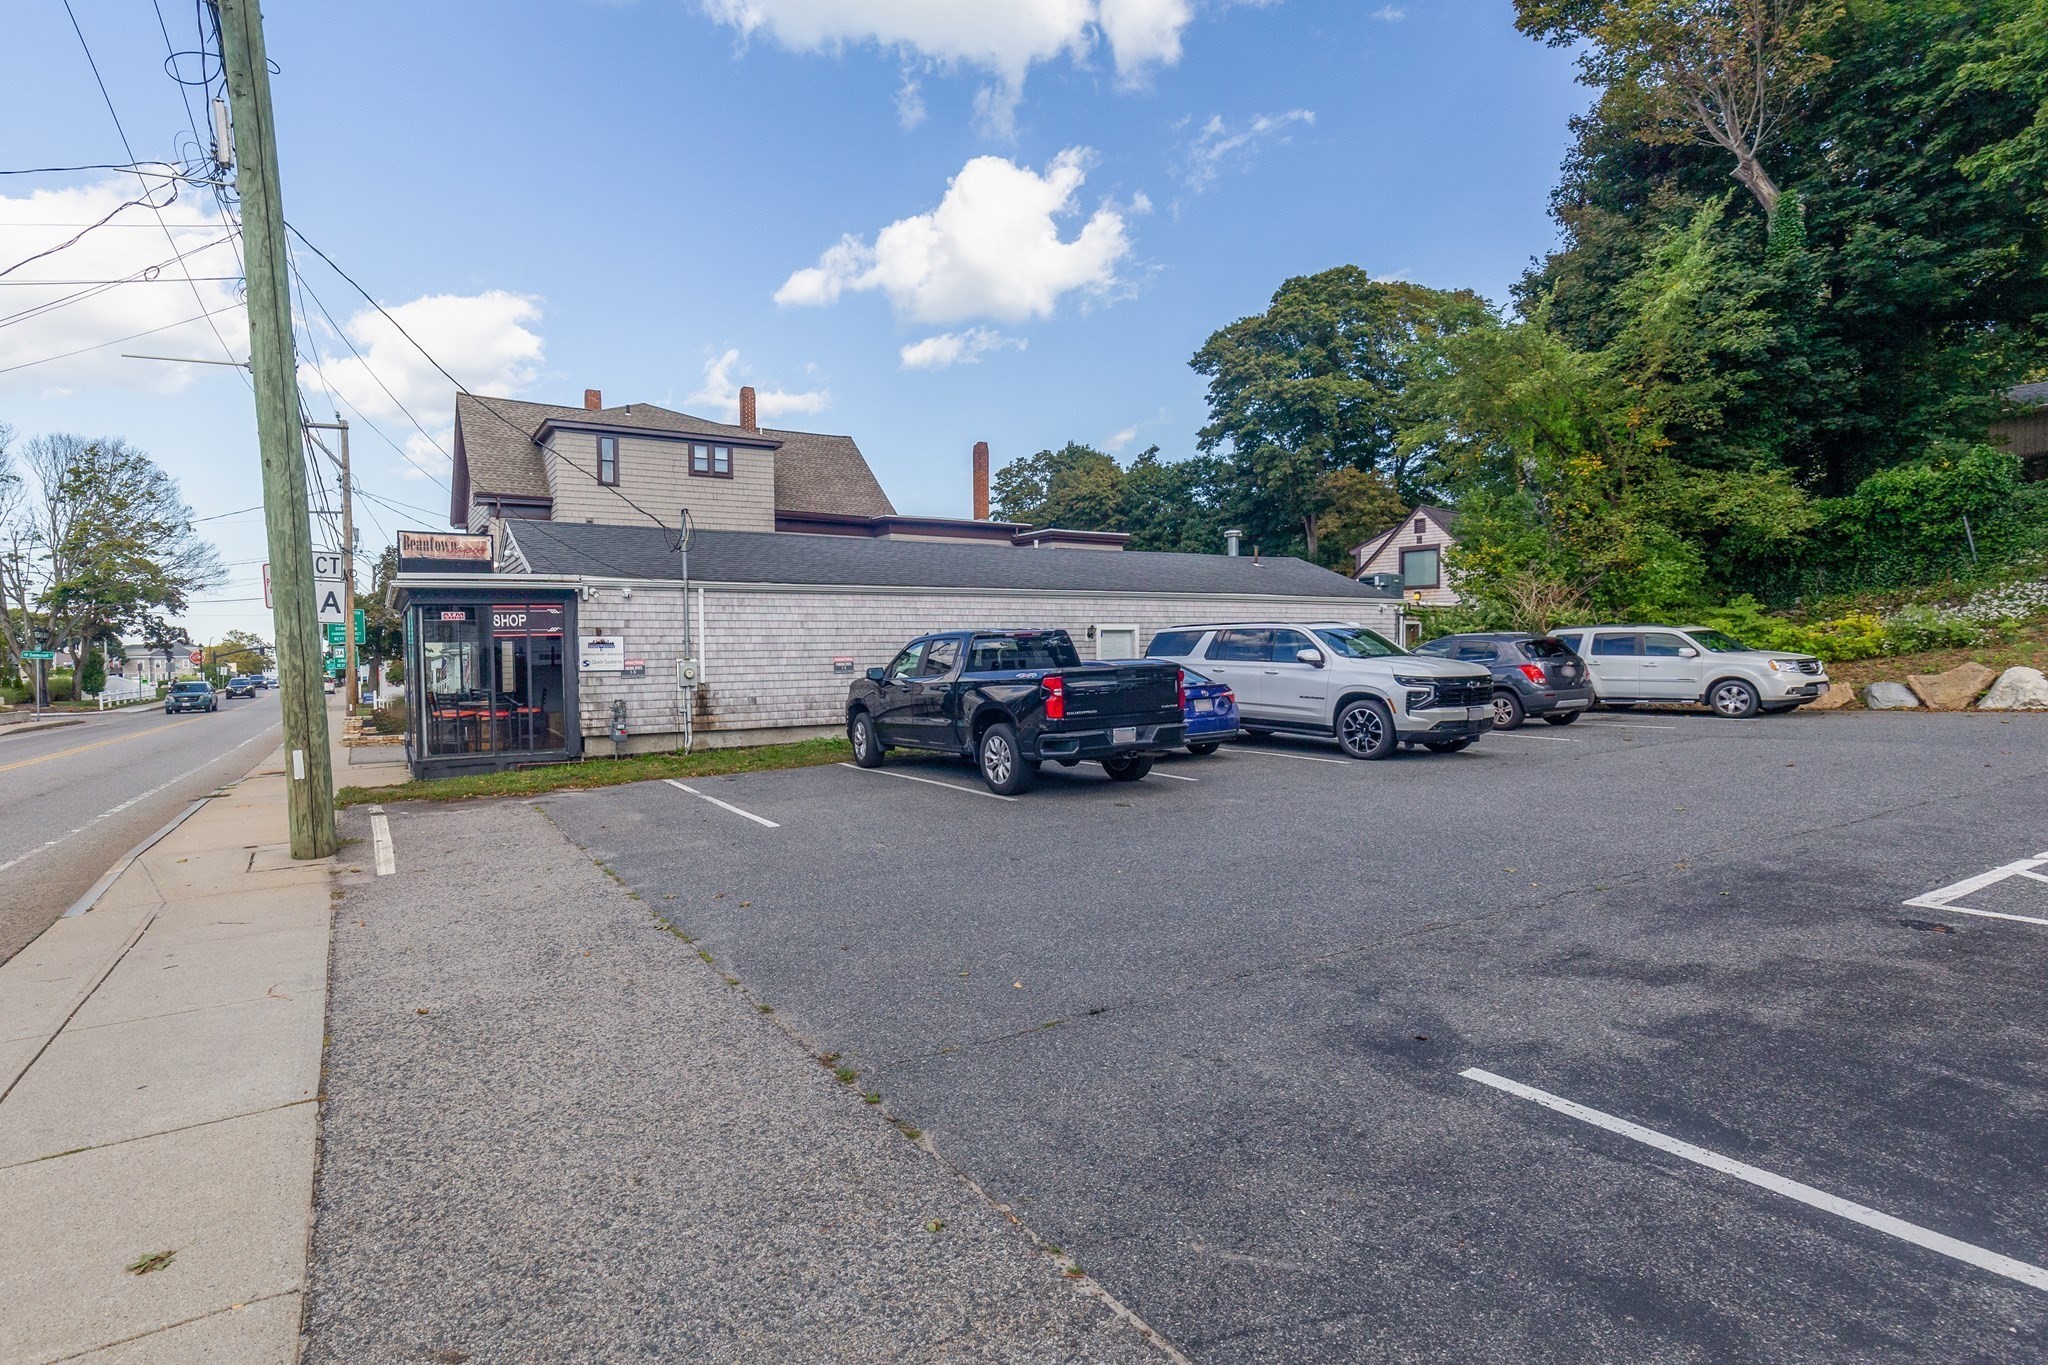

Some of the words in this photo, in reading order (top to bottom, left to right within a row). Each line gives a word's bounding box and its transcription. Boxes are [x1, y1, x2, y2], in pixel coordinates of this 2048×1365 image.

[403, 534, 457, 552] Beantown
[315, 556, 340, 574] CT
[320, 590, 342, 614] A
[493, 614, 527, 627] SHOP
